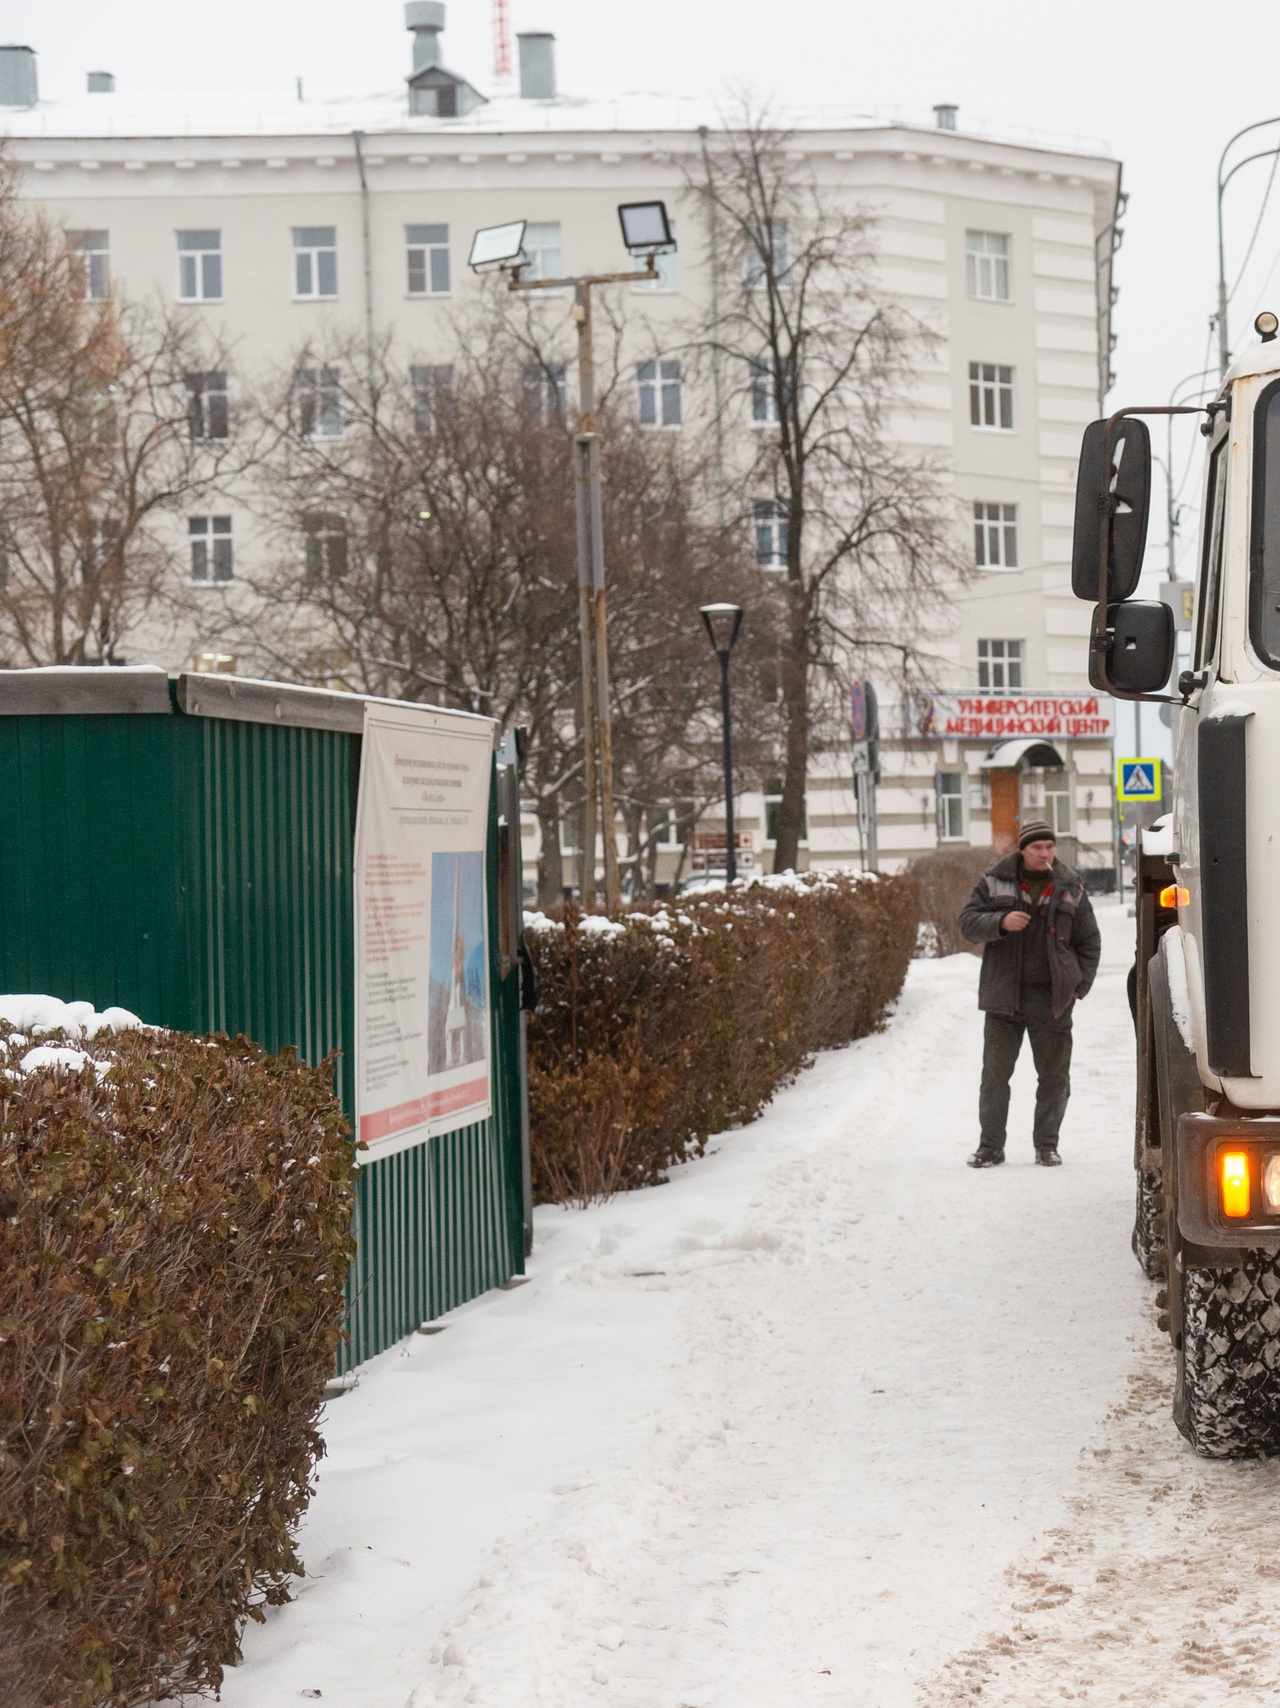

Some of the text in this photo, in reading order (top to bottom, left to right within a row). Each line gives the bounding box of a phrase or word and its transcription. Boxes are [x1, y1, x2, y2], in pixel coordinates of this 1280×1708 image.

[958, 697, 1098, 716] УНИВЕРСИТЕТСКИЙ
[946, 715, 1110, 736] МЕДИЦИНСКИЙ ЦЕНТР
